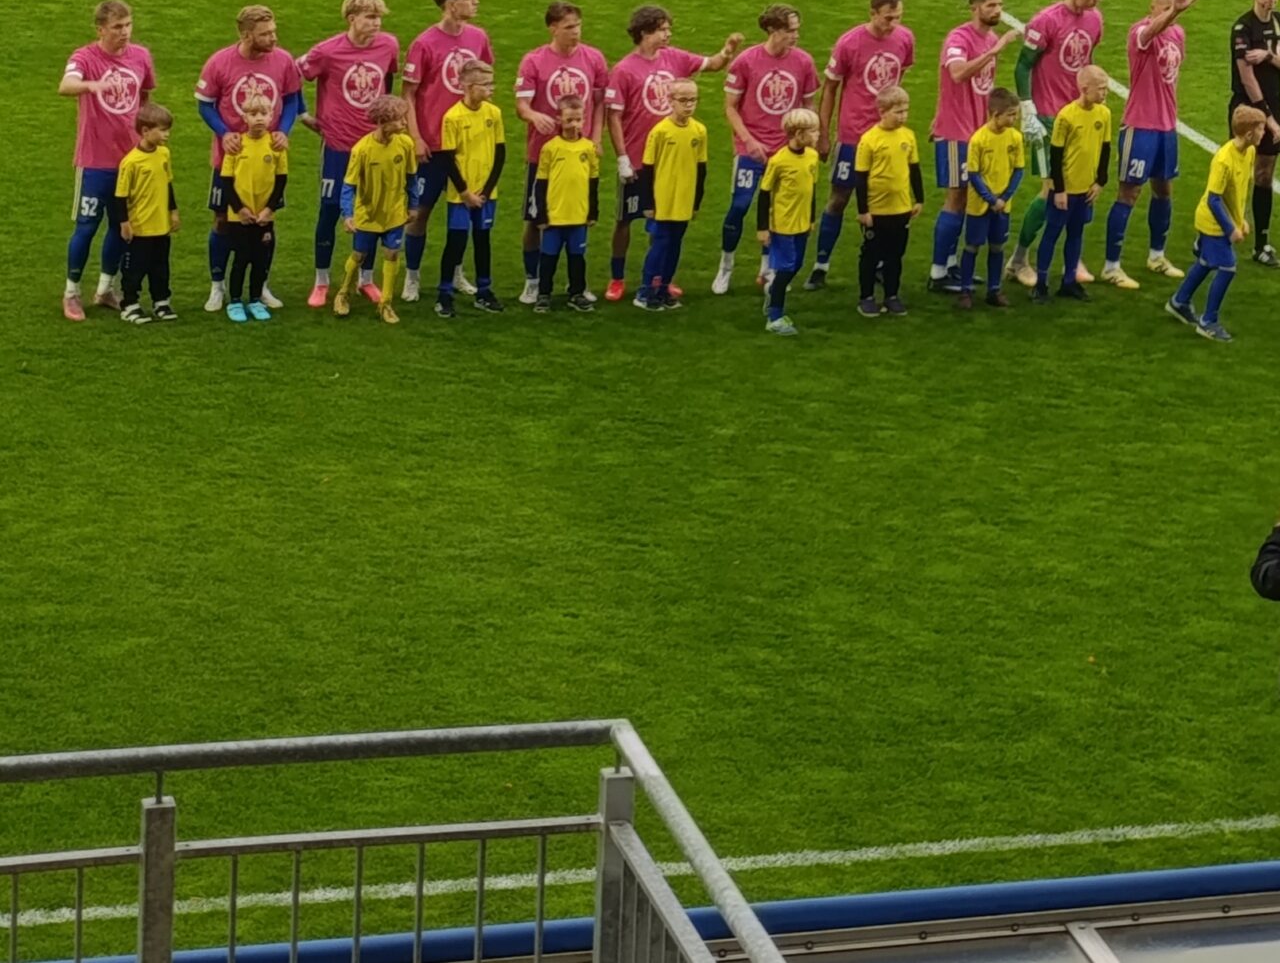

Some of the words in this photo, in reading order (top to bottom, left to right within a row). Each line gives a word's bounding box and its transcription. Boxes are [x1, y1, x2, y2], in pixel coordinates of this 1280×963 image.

[737, 169, 754, 188] 53
[838, 161, 851, 181] 15
[81, 196, 99, 216] 52
